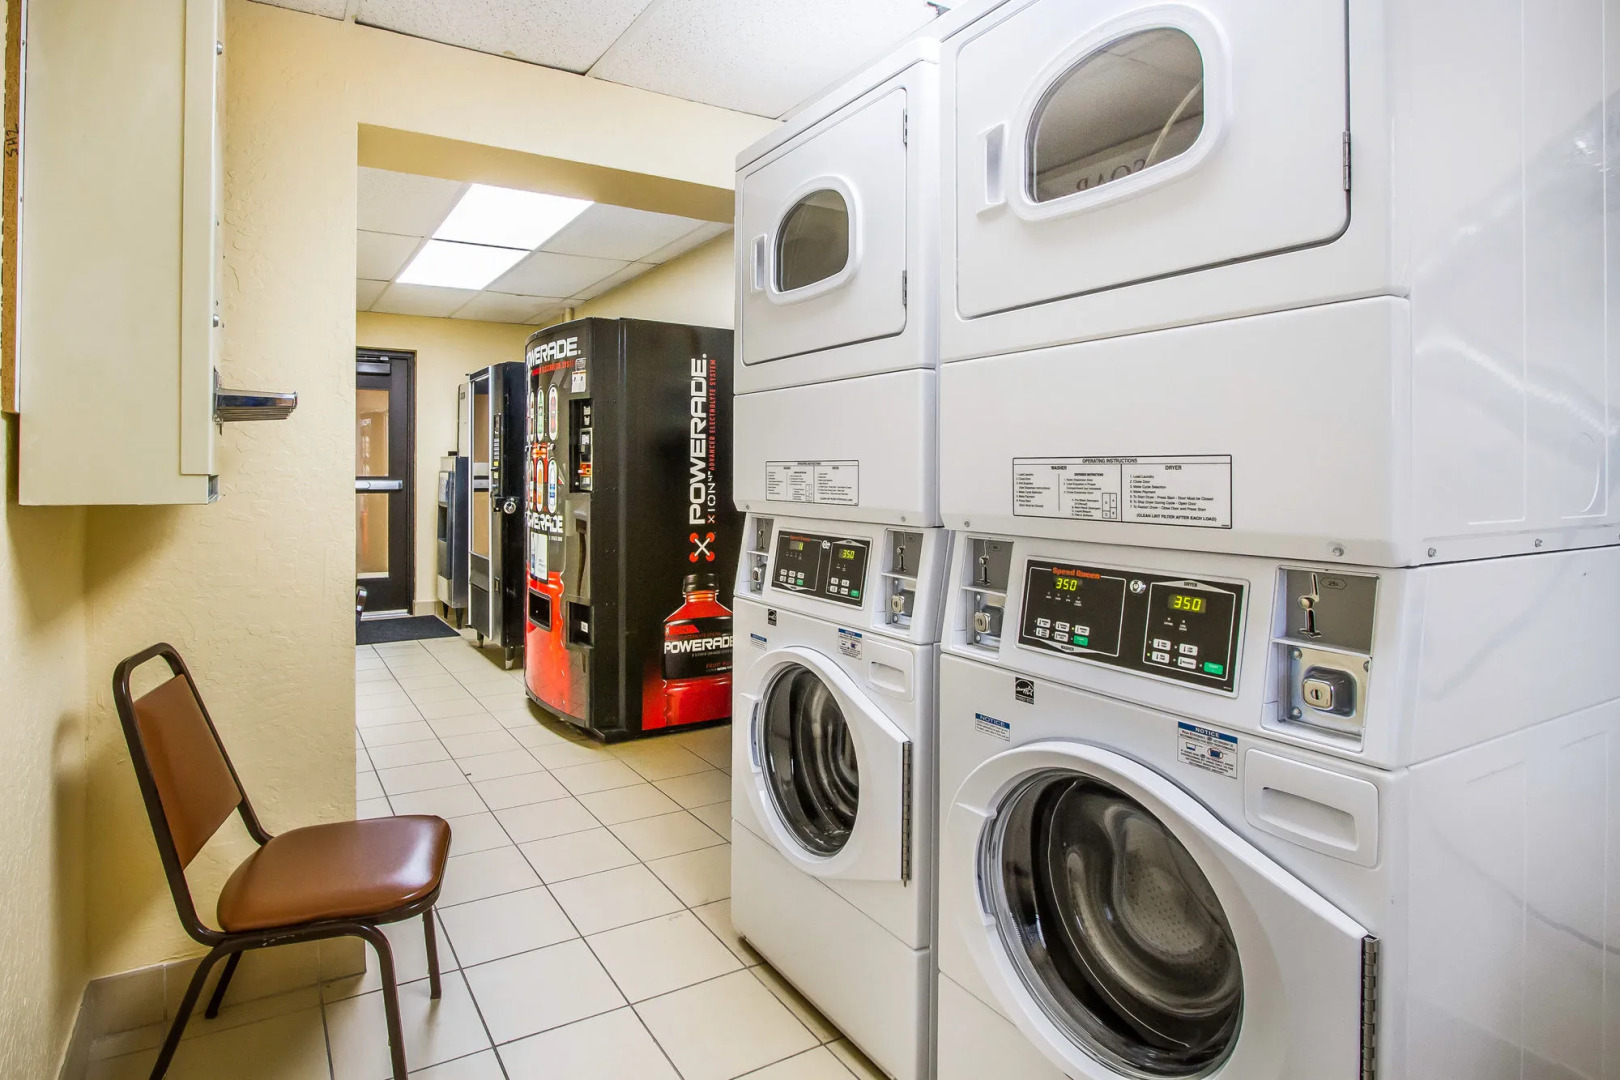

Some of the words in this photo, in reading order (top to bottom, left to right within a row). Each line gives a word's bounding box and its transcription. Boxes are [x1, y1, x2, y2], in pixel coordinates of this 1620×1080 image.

[526, 336, 581, 368] OWERADE.
[709, 359, 717, 386] SYSTEM
[842, 549, 855, 560] 350
[1053, 566, 1075, 576] Speed
[1076, 569, 1100, 580] Queen
[1055, 577, 1078, 591] 350
[1173, 595, 1202, 611] 350
[980, 715, 1005, 726] NOTICE
[1195, 727, 1219, 738] NOTICE
